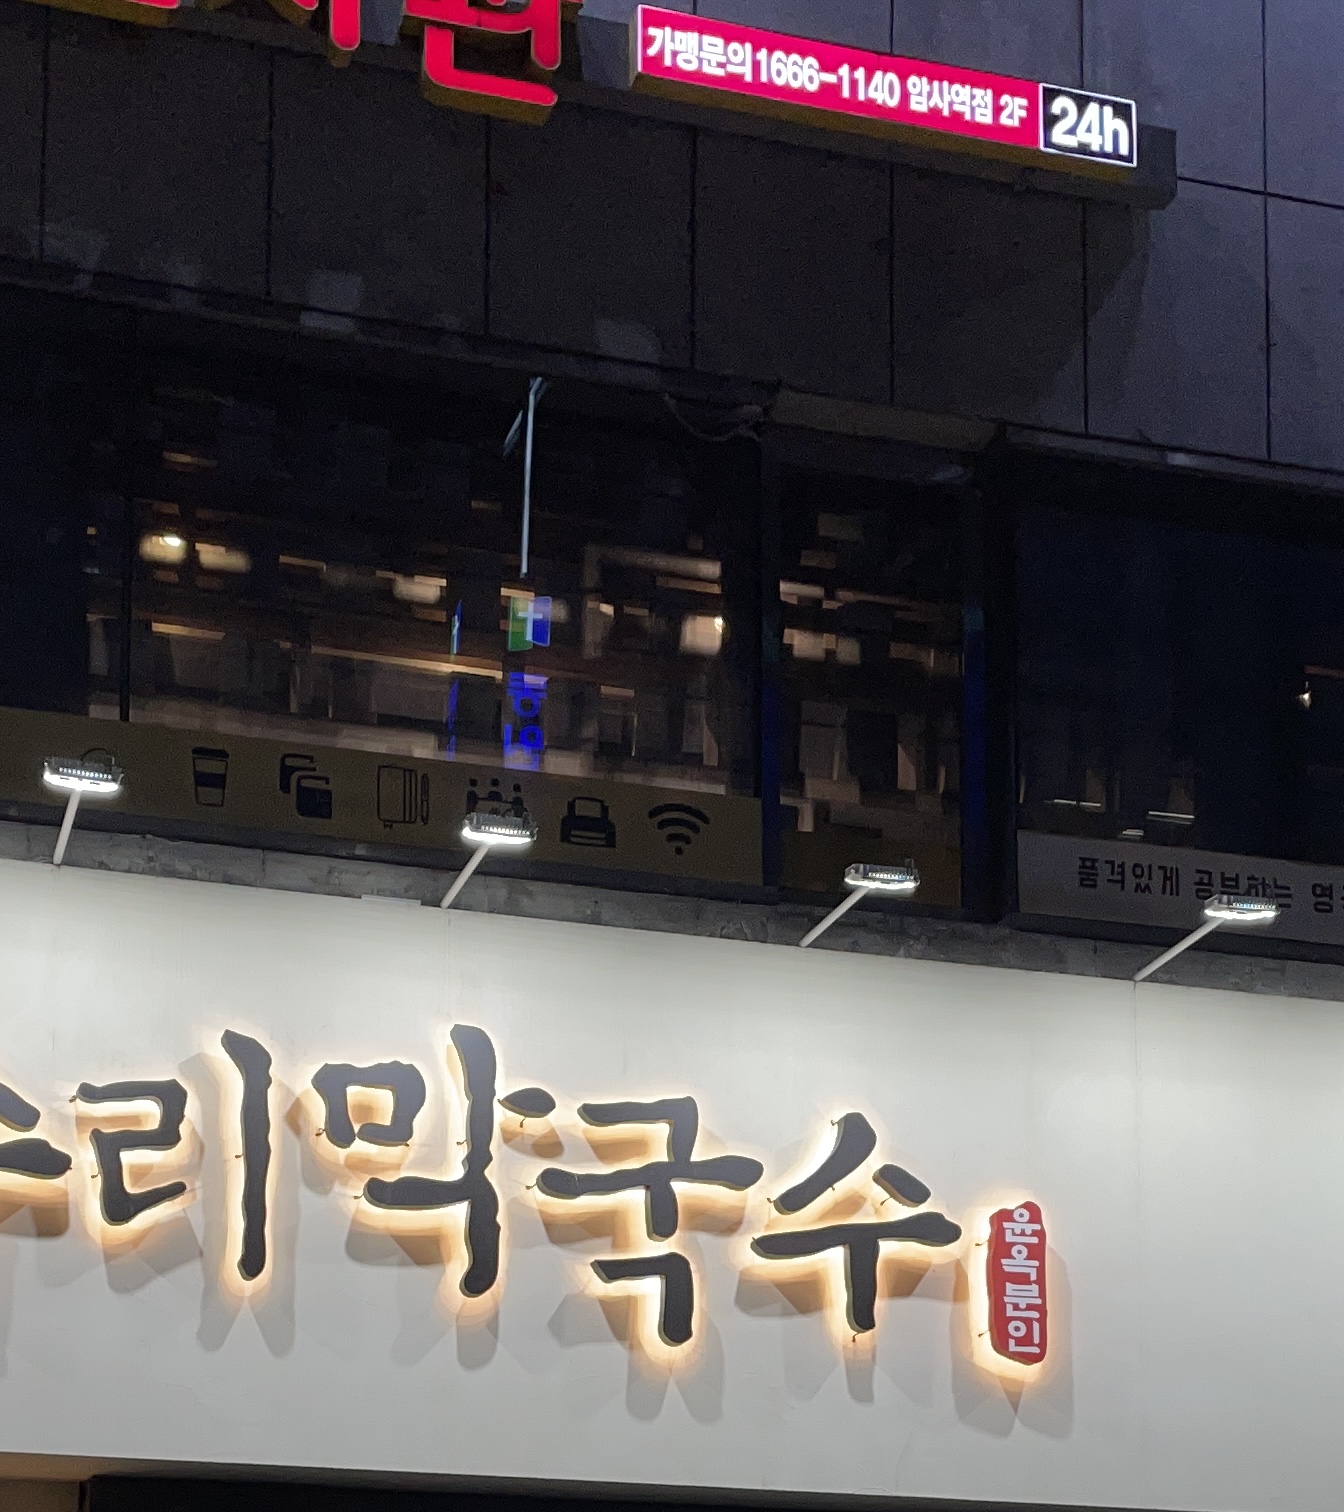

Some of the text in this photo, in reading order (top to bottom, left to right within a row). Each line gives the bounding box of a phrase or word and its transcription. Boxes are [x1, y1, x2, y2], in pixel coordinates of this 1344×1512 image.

[906, 73, 994, 126] 암사역점
[999, 96, 1029, 128] 2F
[1049, 99, 1130, 158] 24h
[1076, 855, 1181, 898] 품격있게
